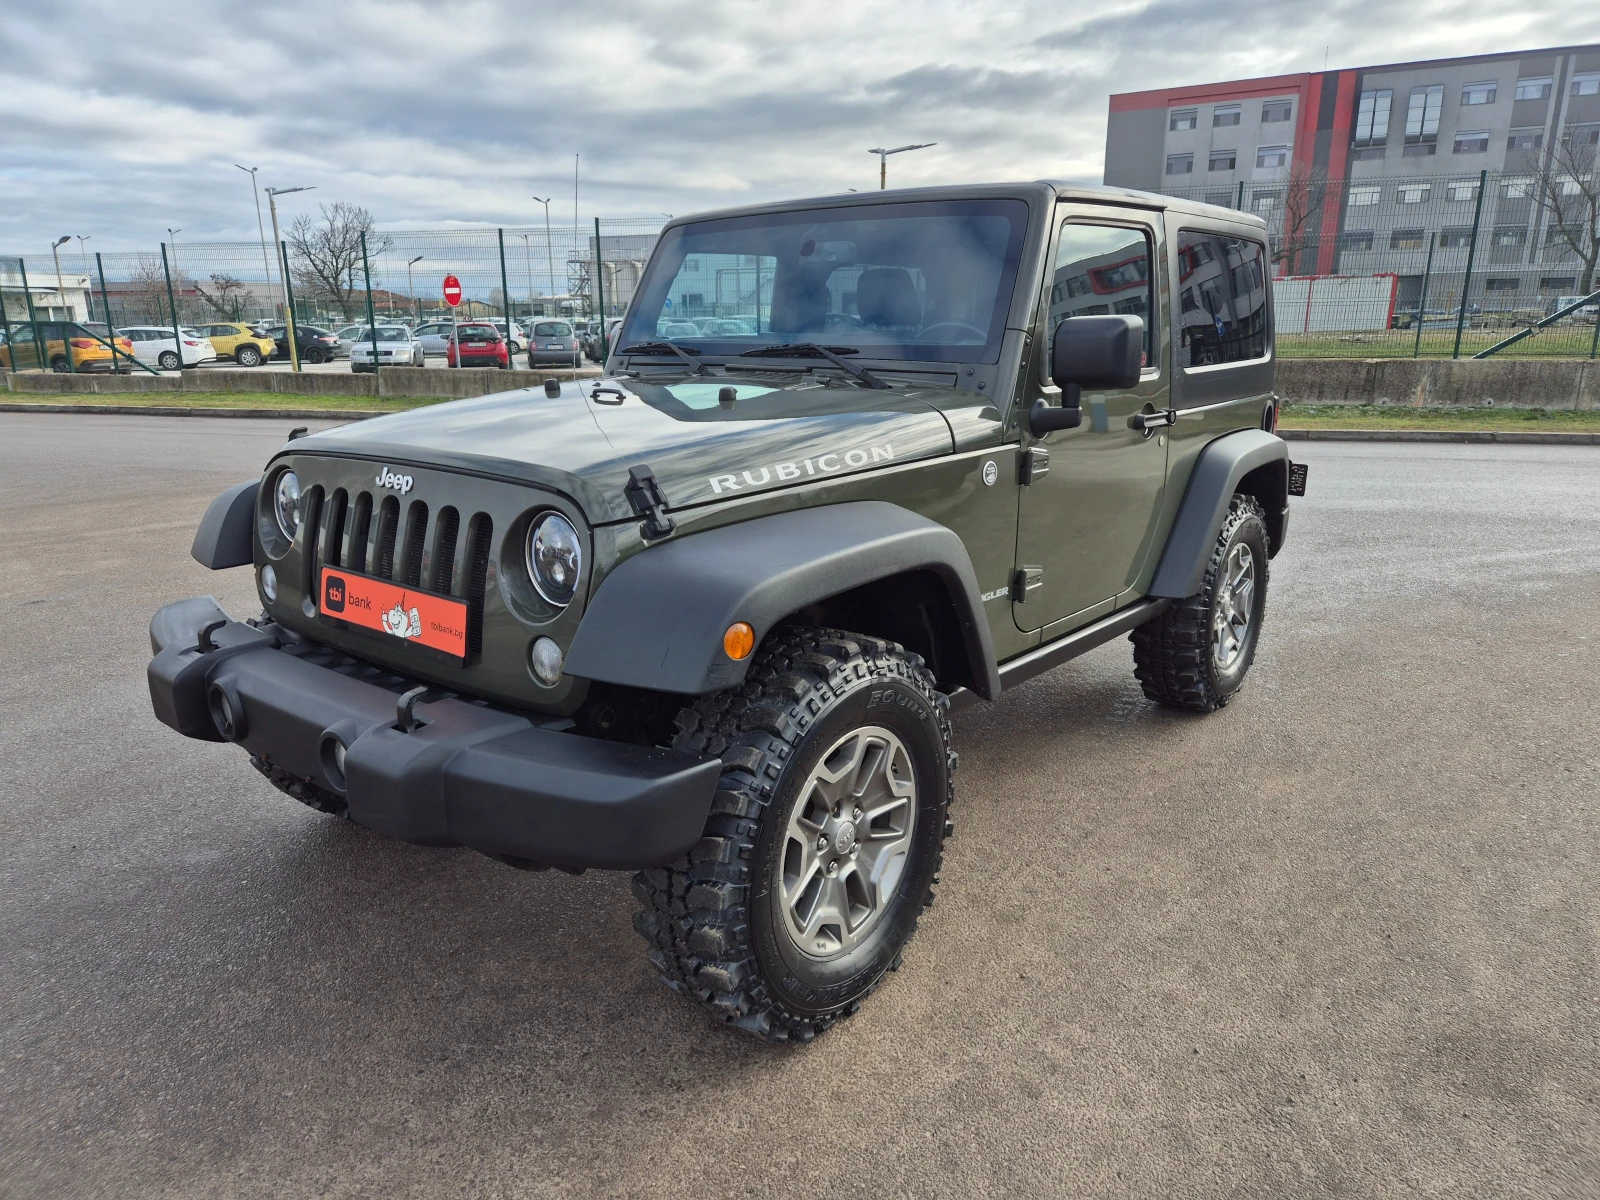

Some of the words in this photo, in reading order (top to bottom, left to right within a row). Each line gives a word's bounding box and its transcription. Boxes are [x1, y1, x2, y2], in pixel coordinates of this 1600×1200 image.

[375, 466, 413, 495] Jeep
[708, 444, 894, 494] RUBICON
[329, 587, 342, 602] tbi
[348, 592, 372, 611] bank
[430, 621, 463, 639] tbibank.bg
